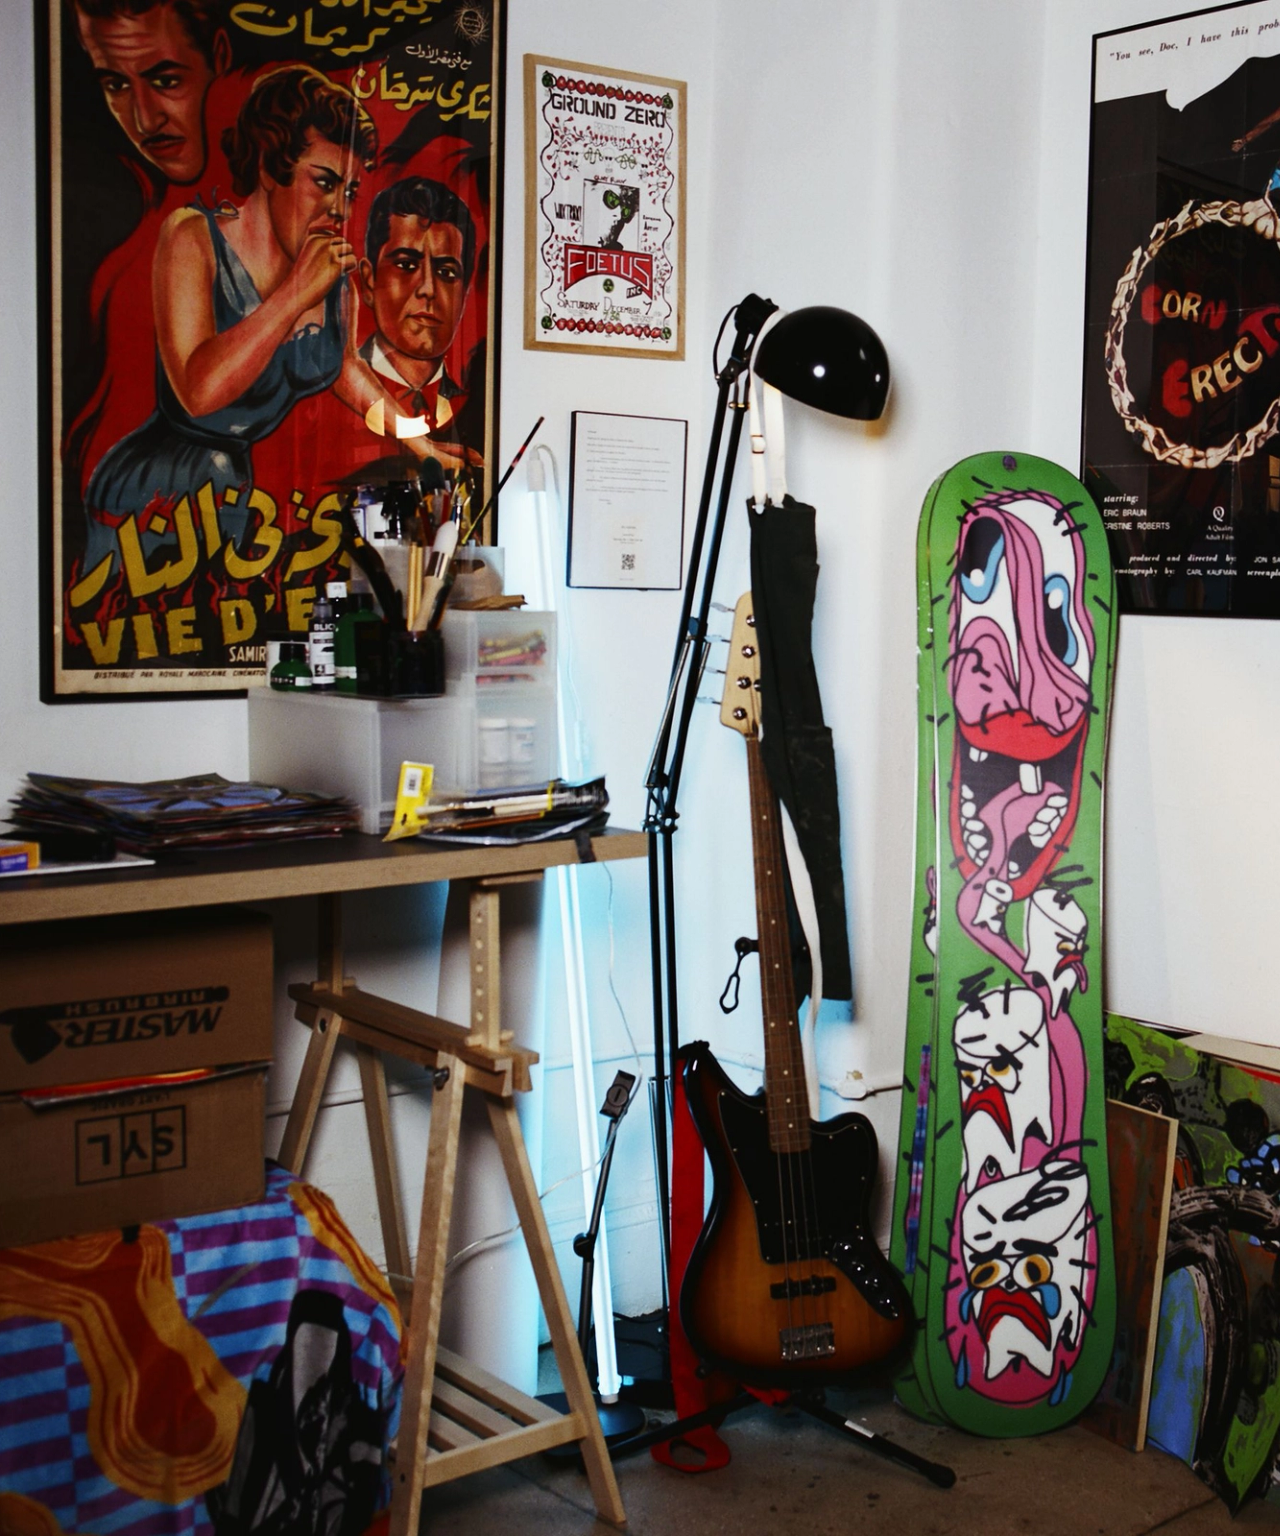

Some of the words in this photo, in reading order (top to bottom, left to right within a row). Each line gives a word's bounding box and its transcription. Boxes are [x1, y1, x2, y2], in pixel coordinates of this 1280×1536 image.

[1200, 32, 1222, 44] have
[1231, 26, 1249, 38] this
[551, 93, 616, 120] GROUND
[624, 105, 666, 128] ZERO
[567, 249, 651, 292] FOETUS
[626, 286, 643, 298] INC
[1103, 493, 1139, 506] starring:
[1103, 509, 1119, 517] ERIC
[1137, 522, 1170, 530] ROBERTS
[70, 481, 222, 607] النار
[1128, 554, 1160, 564] produced
[1187, 553, 1218, 562] directed
[1187, 568, 1203, 576] CARL
[1207, 568, 1237, 576] KAUFMAN
[80, 607, 203, 666] VIE
[229, 646, 267, 663] SAMIR
[140, 671, 154, 680] PAR
[159, 671, 184, 680] ROYALE
[188, 670, 227, 680] MAROCAINE
[65, 990, 206, 1016] AIRBRUSH
[64, 1005, 223, 1048] MASTER
[87, 1124, 176, 1166] SYL
